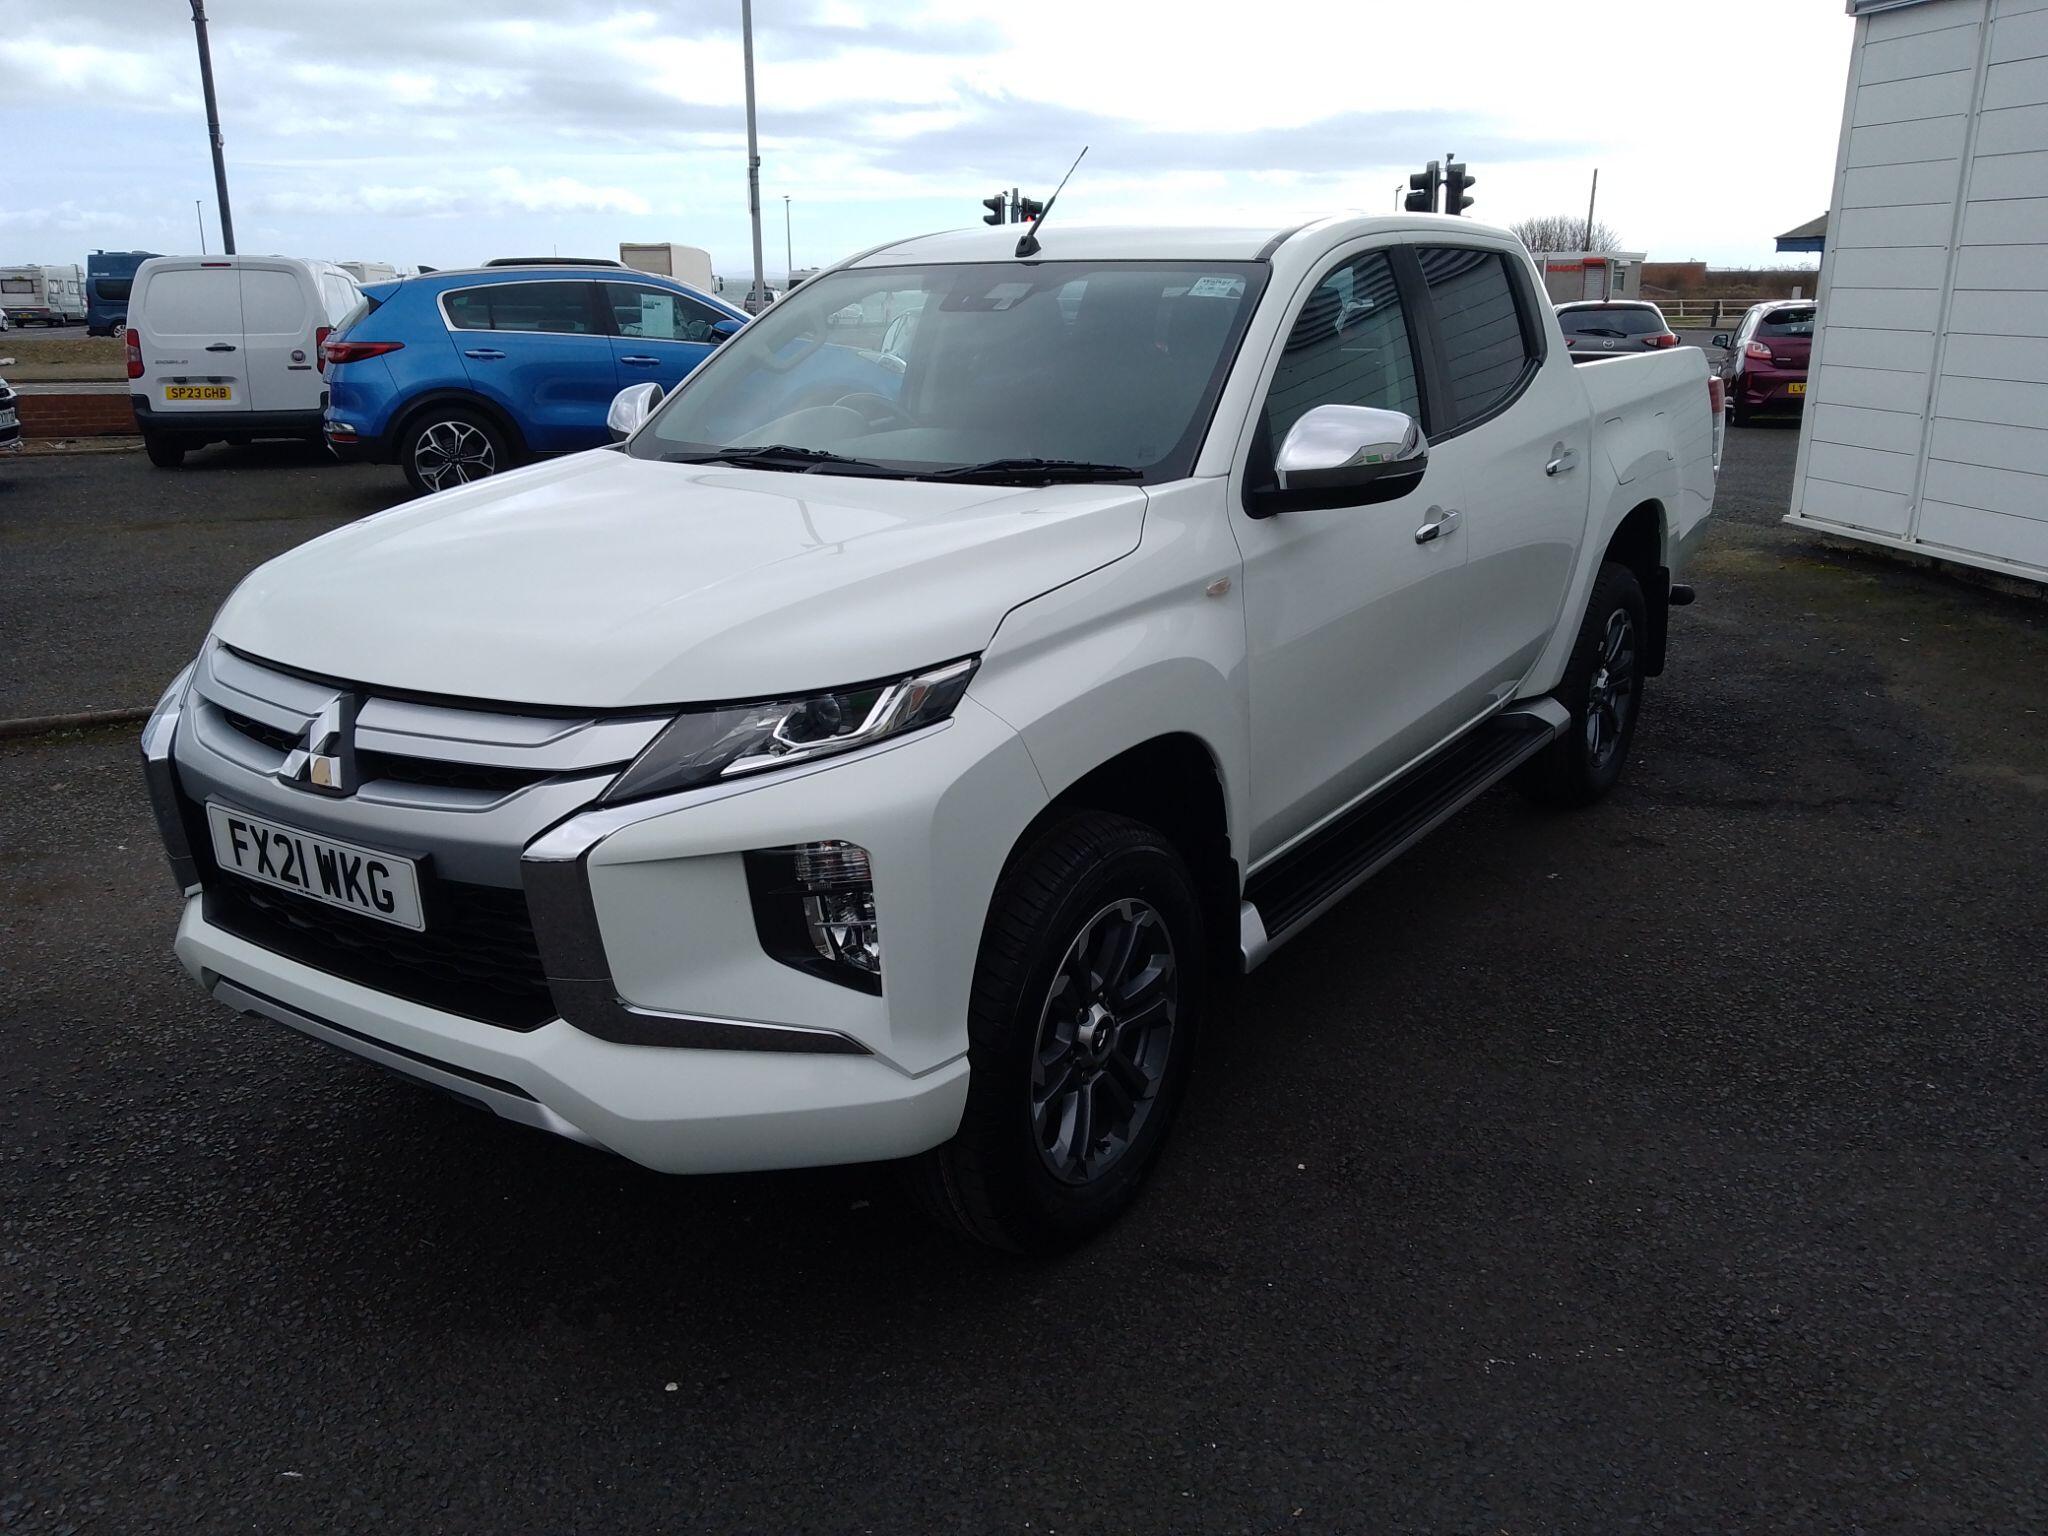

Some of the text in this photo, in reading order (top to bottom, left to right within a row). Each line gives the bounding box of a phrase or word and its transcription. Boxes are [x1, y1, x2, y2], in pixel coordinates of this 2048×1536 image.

[171, 388, 227, 399] SP23 GHB
[228, 818, 395, 914] FX21 WKG
